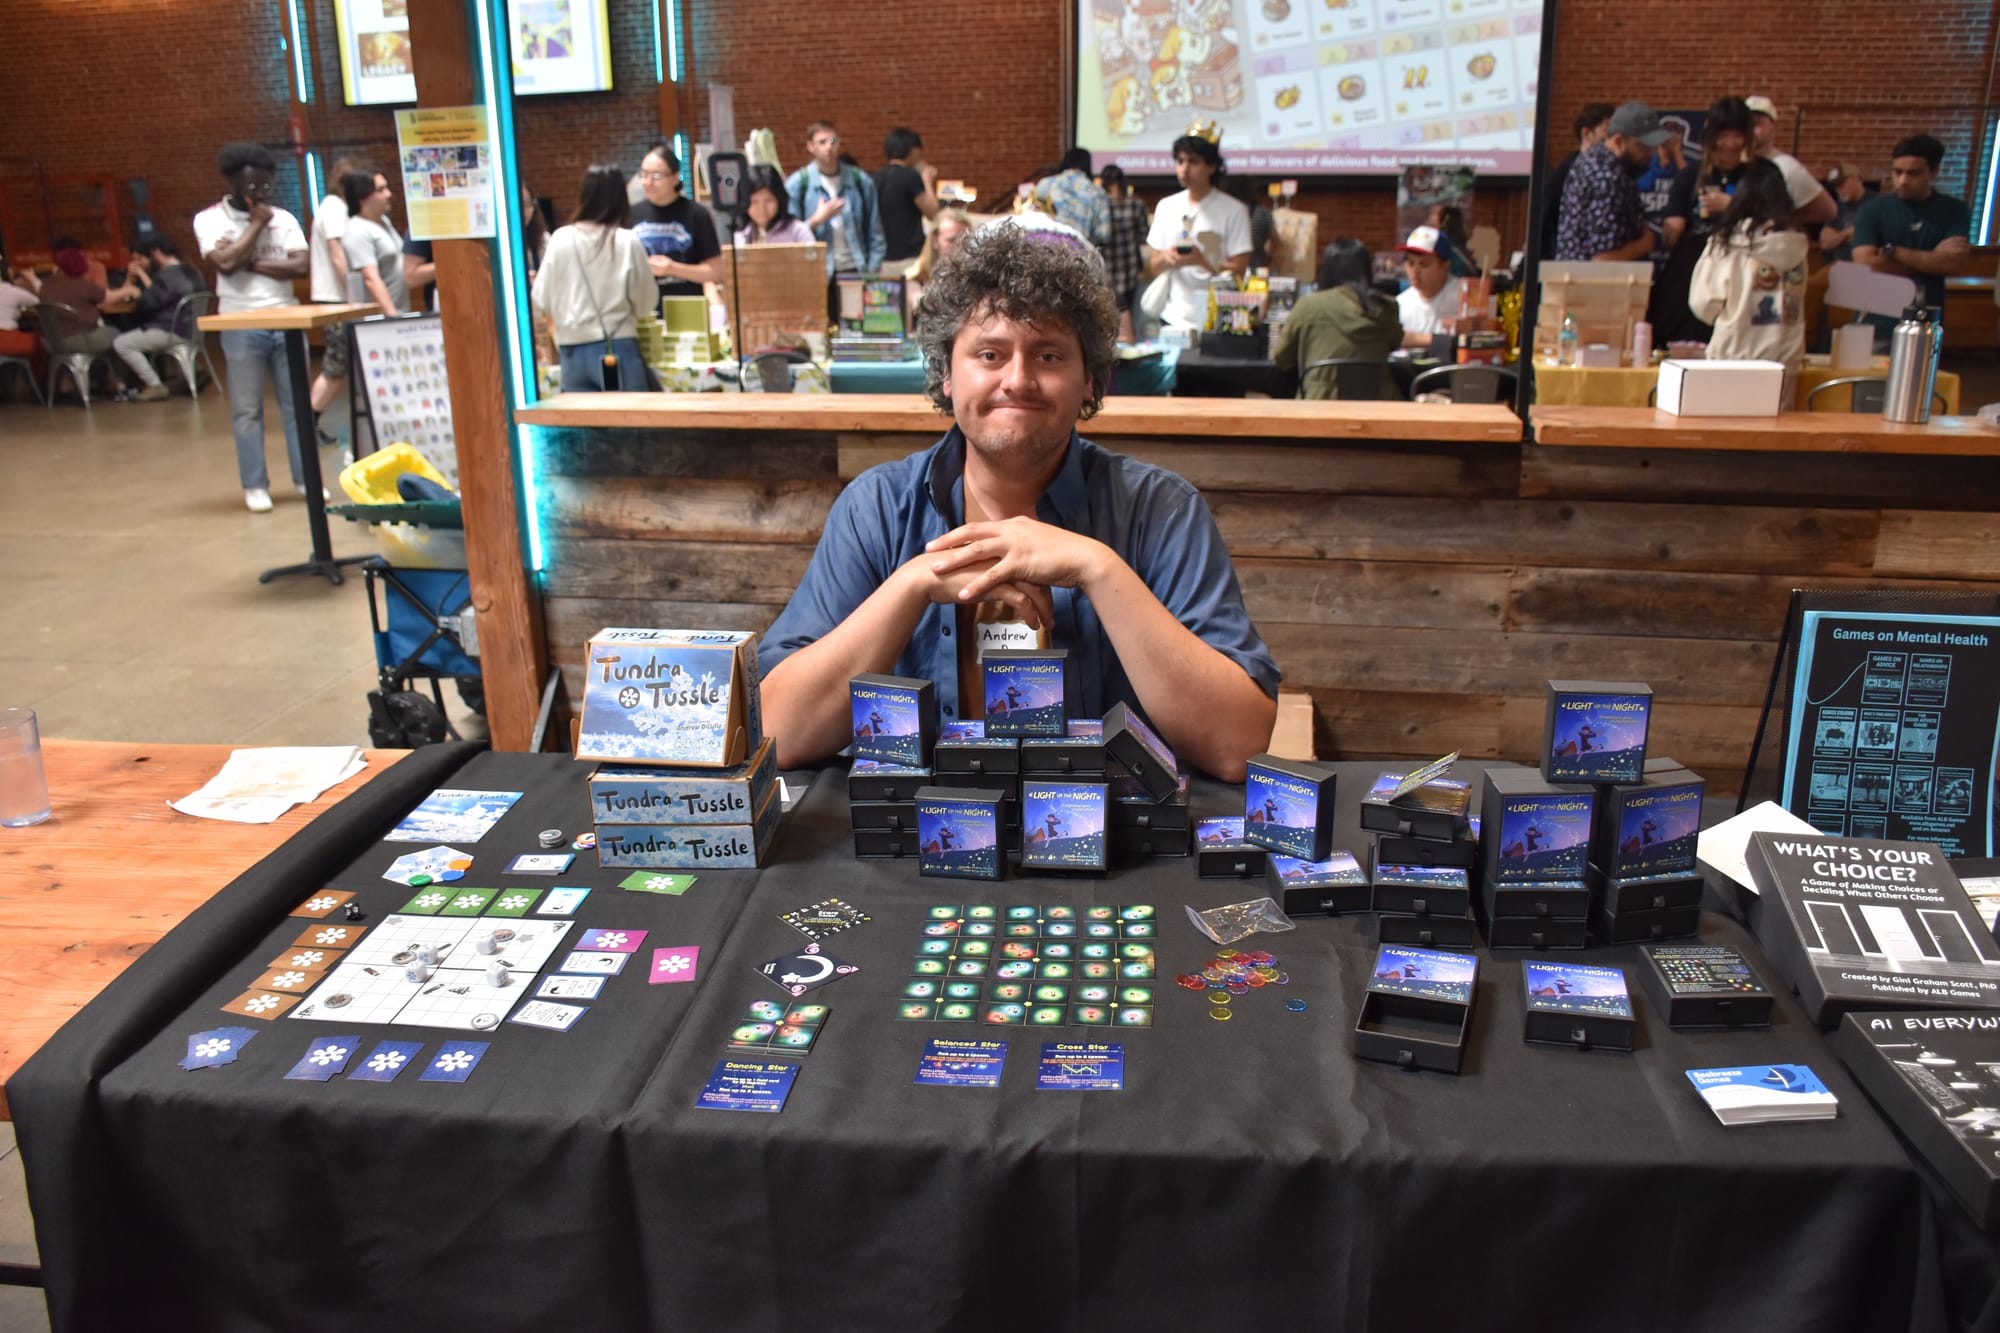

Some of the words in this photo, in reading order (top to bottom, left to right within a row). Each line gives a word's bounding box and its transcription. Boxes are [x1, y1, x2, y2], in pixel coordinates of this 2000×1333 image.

[1320, 154, 1368, 167] delicious
[983, 628, 1028, 640] Andrew
[1833, 627, 1874, 641] Games
[1877, 630, 1893, 642] on
[1896, 629, 1941, 645] Mental
[1944, 632, 1988, 646] Health
[596, 655, 681, 683] Tundra
[993, 665, 1016, 673] LIGHT
[1032, 665, 1056, 673] NIGHT
[645, 681, 720, 709] Tussle
[858, 691, 877, 699] LIGHT
[890, 695, 912, 703] NIGHT
[1566, 702, 1593, 710] LIGHT
[1612, 702, 1640, 711] NIGHT
[1254, 774, 1275, 785] LIGHT
[1289, 784, 1311, 796] NIGHT
[597, 789, 672, 812] Tundra
[679, 792, 745, 815] Tussle
[1072, 792, 1097, 800] NIGHT
[1630, 798, 1654, 807] LIGHT
[1670, 793, 1694, 802] NIGHT
[1513, 804, 1539, 812] LIGHT
[1557, 802, 1585, 811] NIGHT
[603, 834, 676, 856] Tundra
[684, 838, 750, 860] Tussle
[1774, 842, 1862, 860] WHAT'S
[1868, 848, 1933, 865] YOUR
[1813, 862, 1916, 882] CHOICE?
[1808, 879, 1836, 887] Game
[1838, 880, 1849, 889] of
[1851, 882, 1886, 892] Making
[1888, 884, 1925, 893] Choices
[1802, 886, 1844, 897] Deciding
[1846, 889, 1872, 897] What
[1875, 890, 1908, 900] Others
[1910, 894, 1944, 902] Choose
[1391, 950, 1419, 958] LIGHT
[1437, 956, 1466, 964] NIGHT
[1841, 972, 1878, 982] Created
[1879, 975, 1890, 984] by
[1892, 976, 1911, 985] Gini
[1913, 977, 1948, 987] Graham
[1950, 979, 1977, 989] Scott,
[1979, 982, 1997, 990] PhD
[1872, 983, 1914, 994] Published
[1916, 986, 1928, 995] by
[1950, 989, 1980, 998] Games
[1871, 1019, 1891, 1030] AI
[1904, 1017, 2000, 1031] EVERYW
[933, 1039, 976, 1047] Balanced
[726, 1062, 763, 1071] Dancing
[1697, 1076, 1731, 1084] Games
